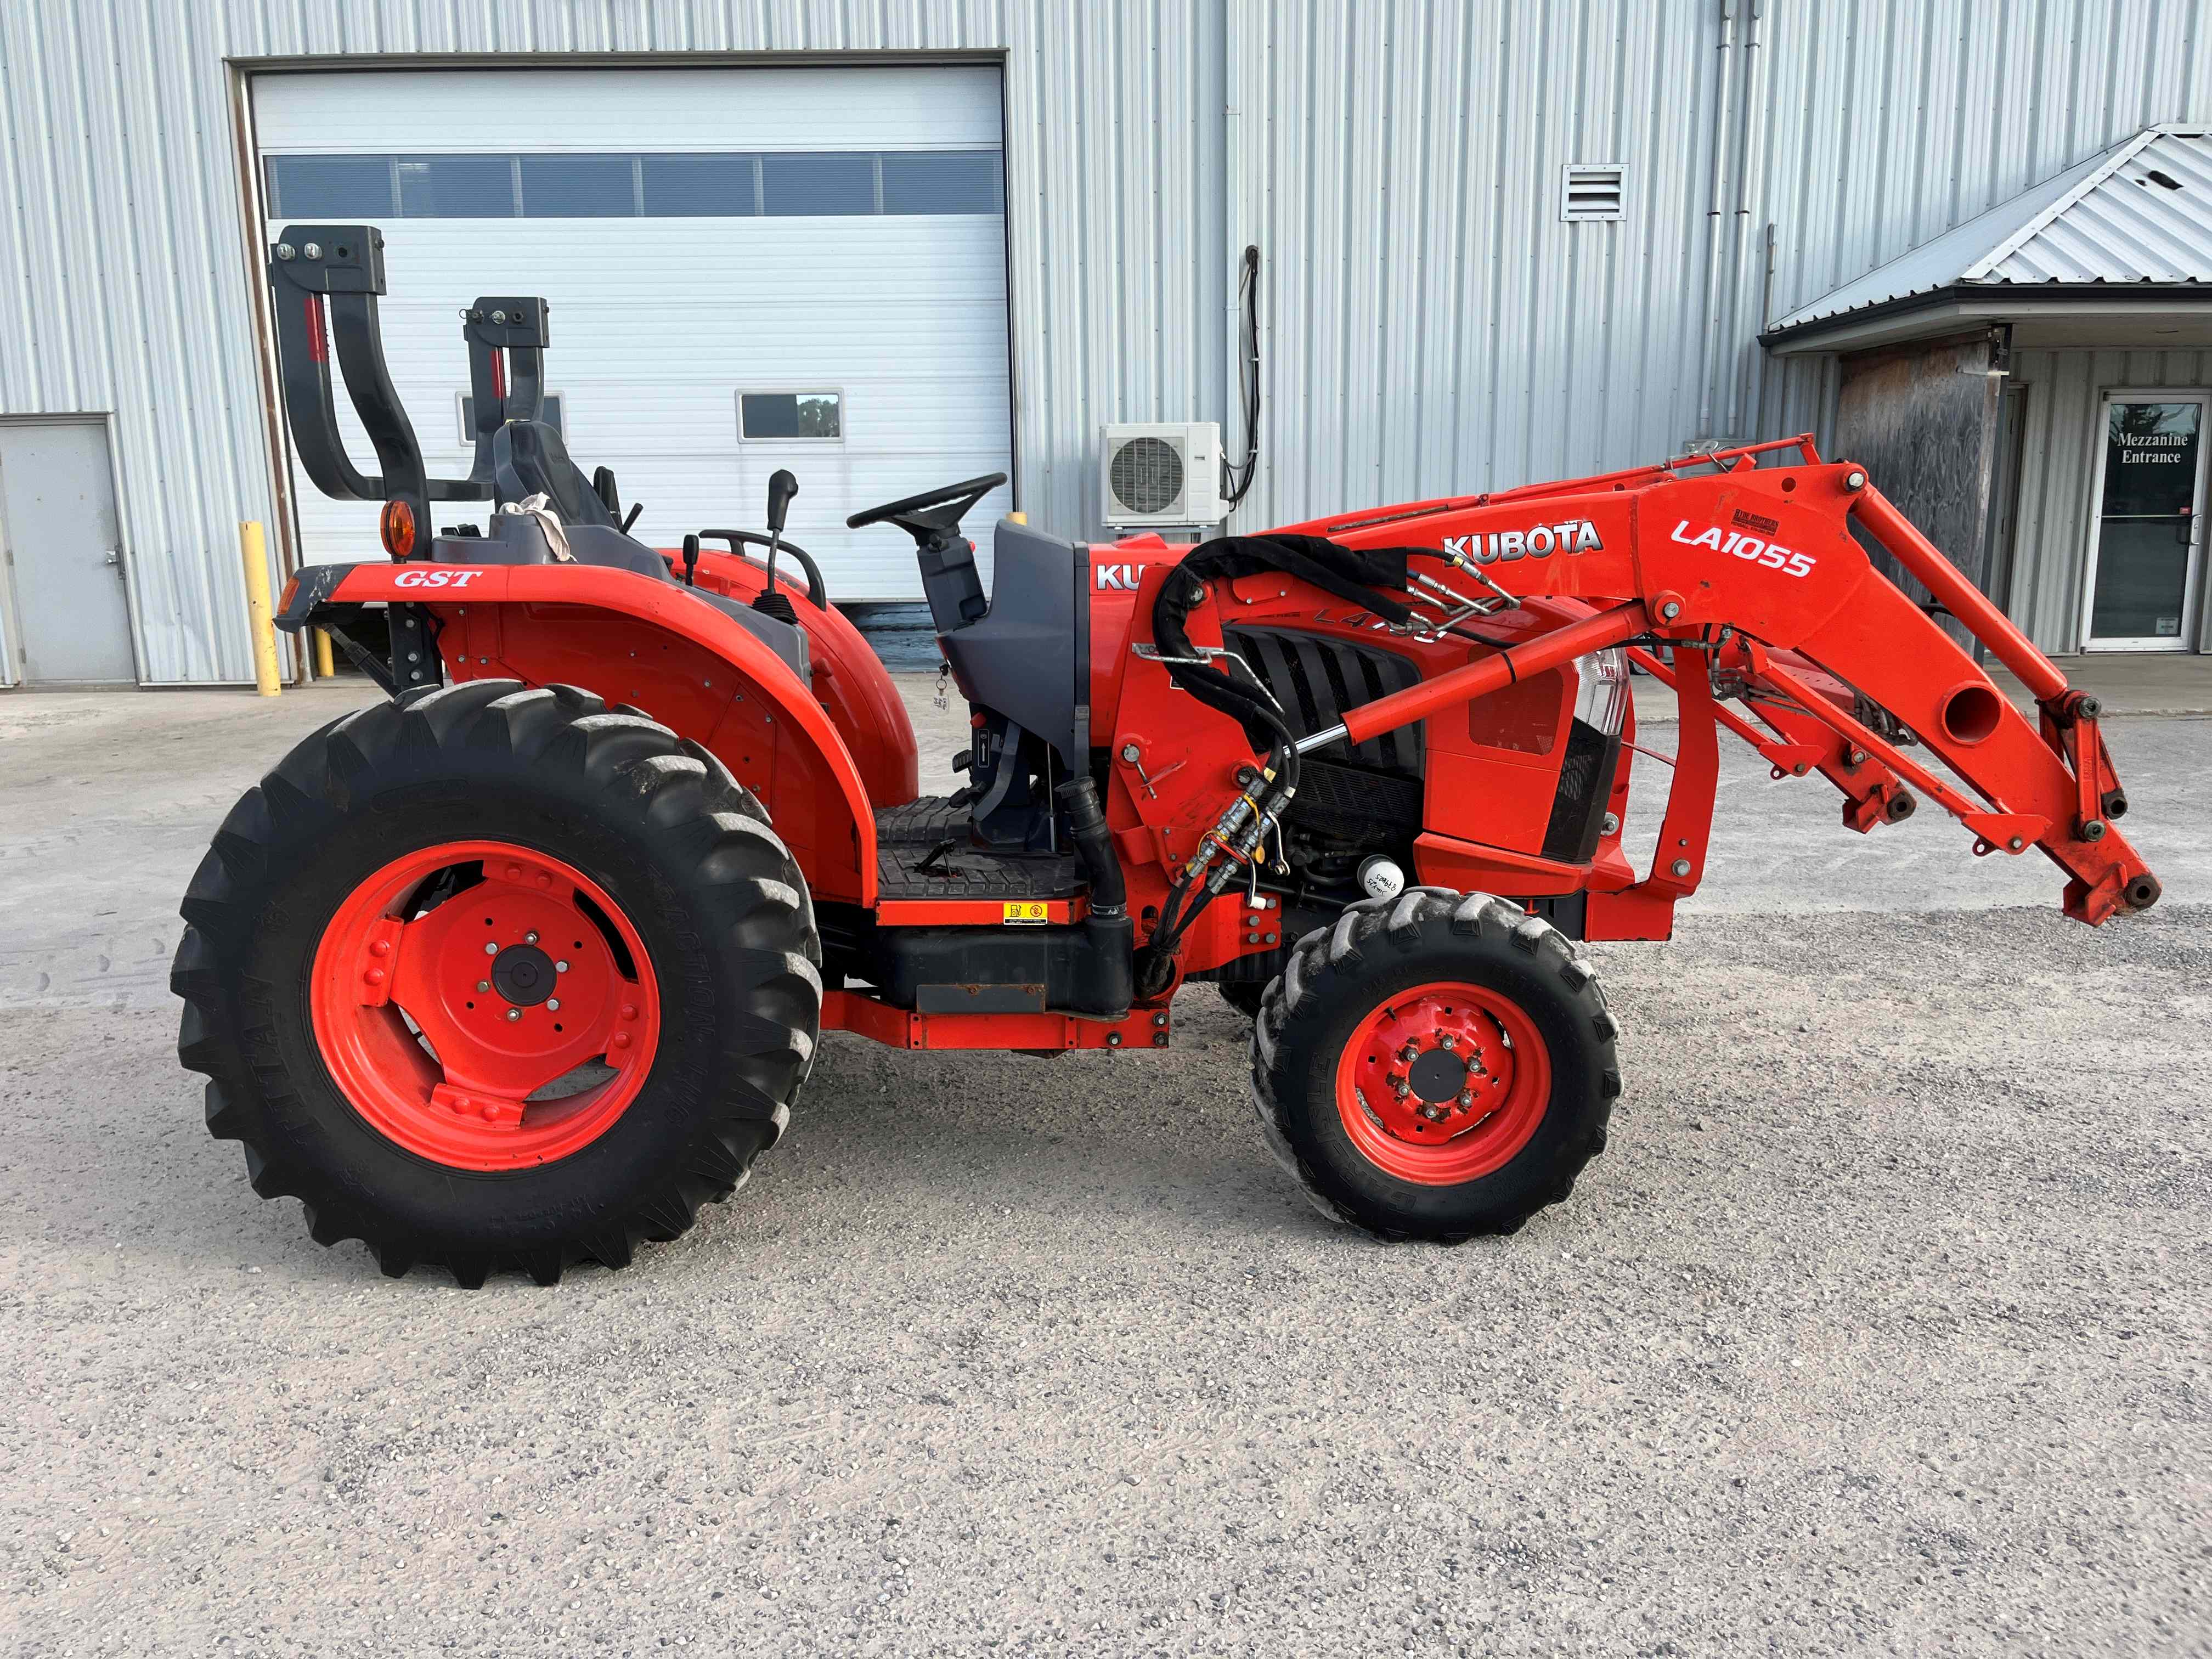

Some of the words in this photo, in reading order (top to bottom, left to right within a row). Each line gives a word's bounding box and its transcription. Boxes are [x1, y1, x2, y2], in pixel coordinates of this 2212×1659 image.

[2117, 432, 2188, 447] Mezzanine
[2121, 449, 2181, 464] Entrance
[1443, 520, 1604, 568] KUBOTA
[1671, 520, 1817, 578] LA1055
[394, 571, 483, 588] GST
[237, 967, 326, 1146] TITAN
[1306, 1052, 1417, 1215] CARLISLE
